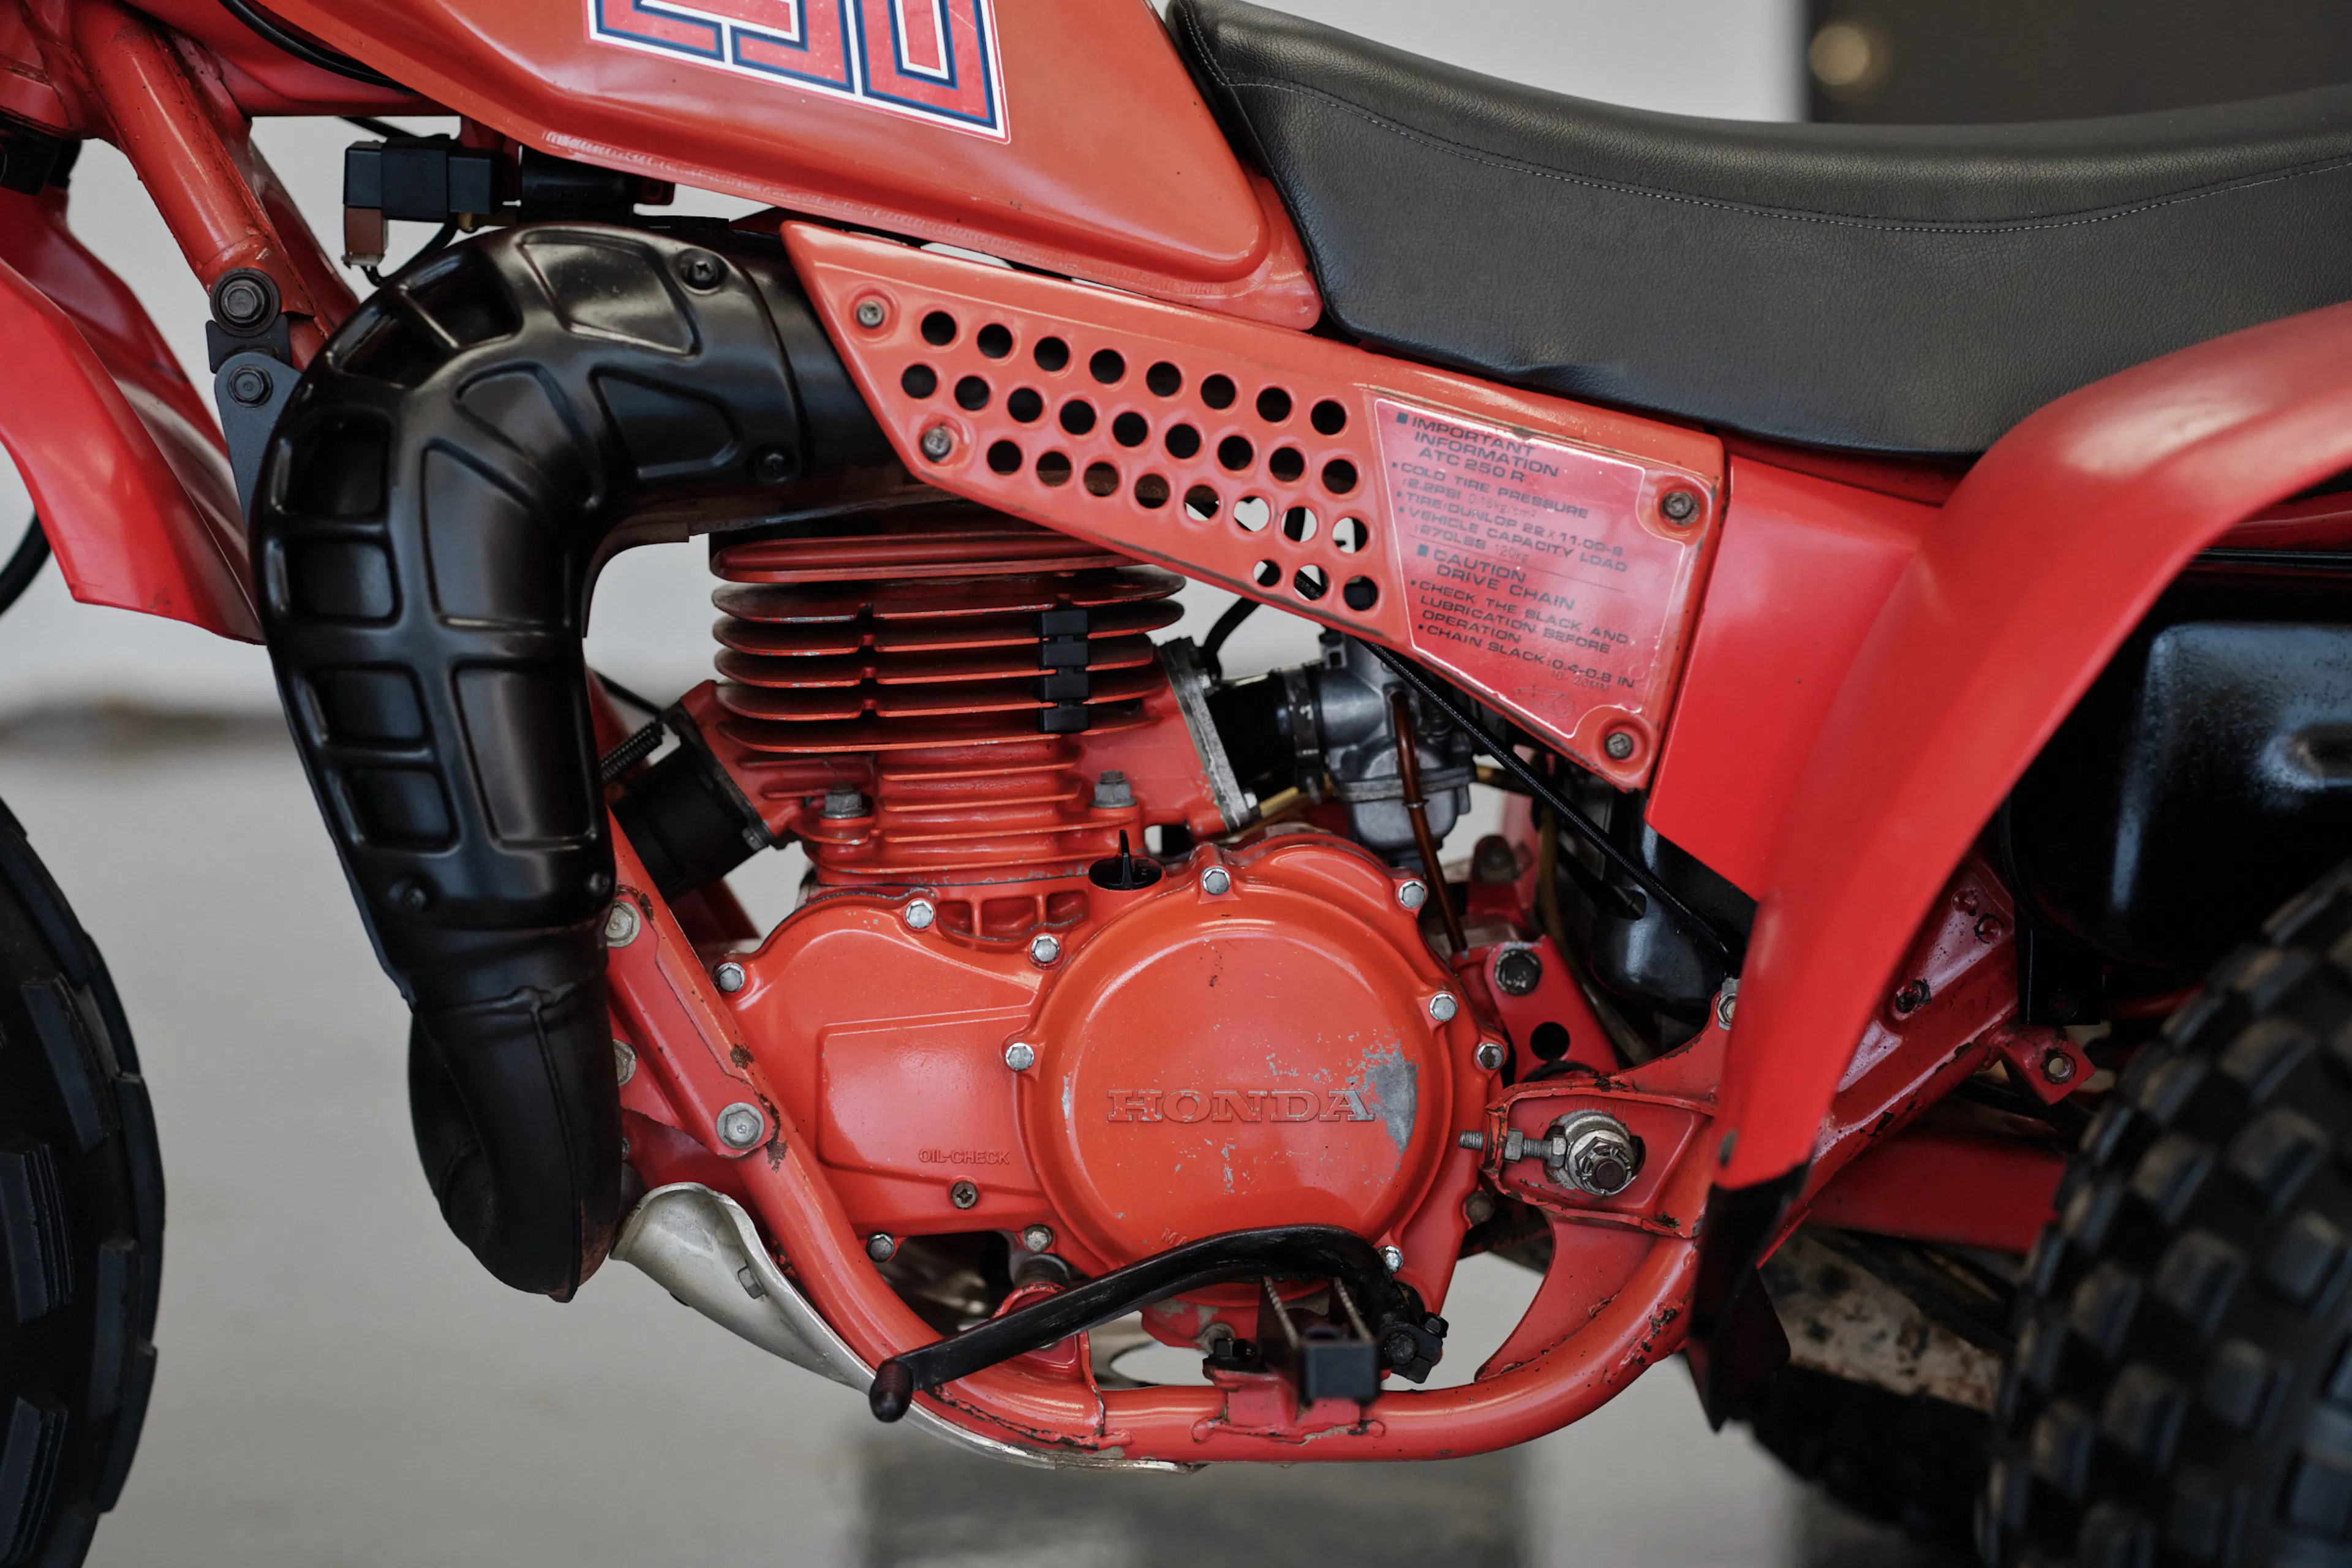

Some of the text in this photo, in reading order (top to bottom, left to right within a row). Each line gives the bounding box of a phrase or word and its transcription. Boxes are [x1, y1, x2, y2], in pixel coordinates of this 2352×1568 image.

[1411, 417, 1534, 456] IMPORTANT
[1414, 431, 1559, 477] INFORMATION
[1418, 447, 1525, 483] ATC 250 R
[1400, 462, 1589, 519] COLD TIRE PRESSURE
[1408, 507, 1627, 572] VEHICLE CAPACITY LOAD
[1433, 549, 1526, 583] CAUTION
[1436, 564, 1575, 610] DRIVE CHAIN
[1419, 580, 1629, 644] CHECK THE SLACK AND
[1420, 595, 1610, 654] LUBRICATION BEFORE
[1422, 609, 1521, 643] OPERATION
[1427, 625, 1482, 647] CHAIN
[1616, 676, 1635, 688] IN
[1107, 1089, 1376, 1123] HONDA
[919, 1147, 1010, 1166] OIL-CHECK
